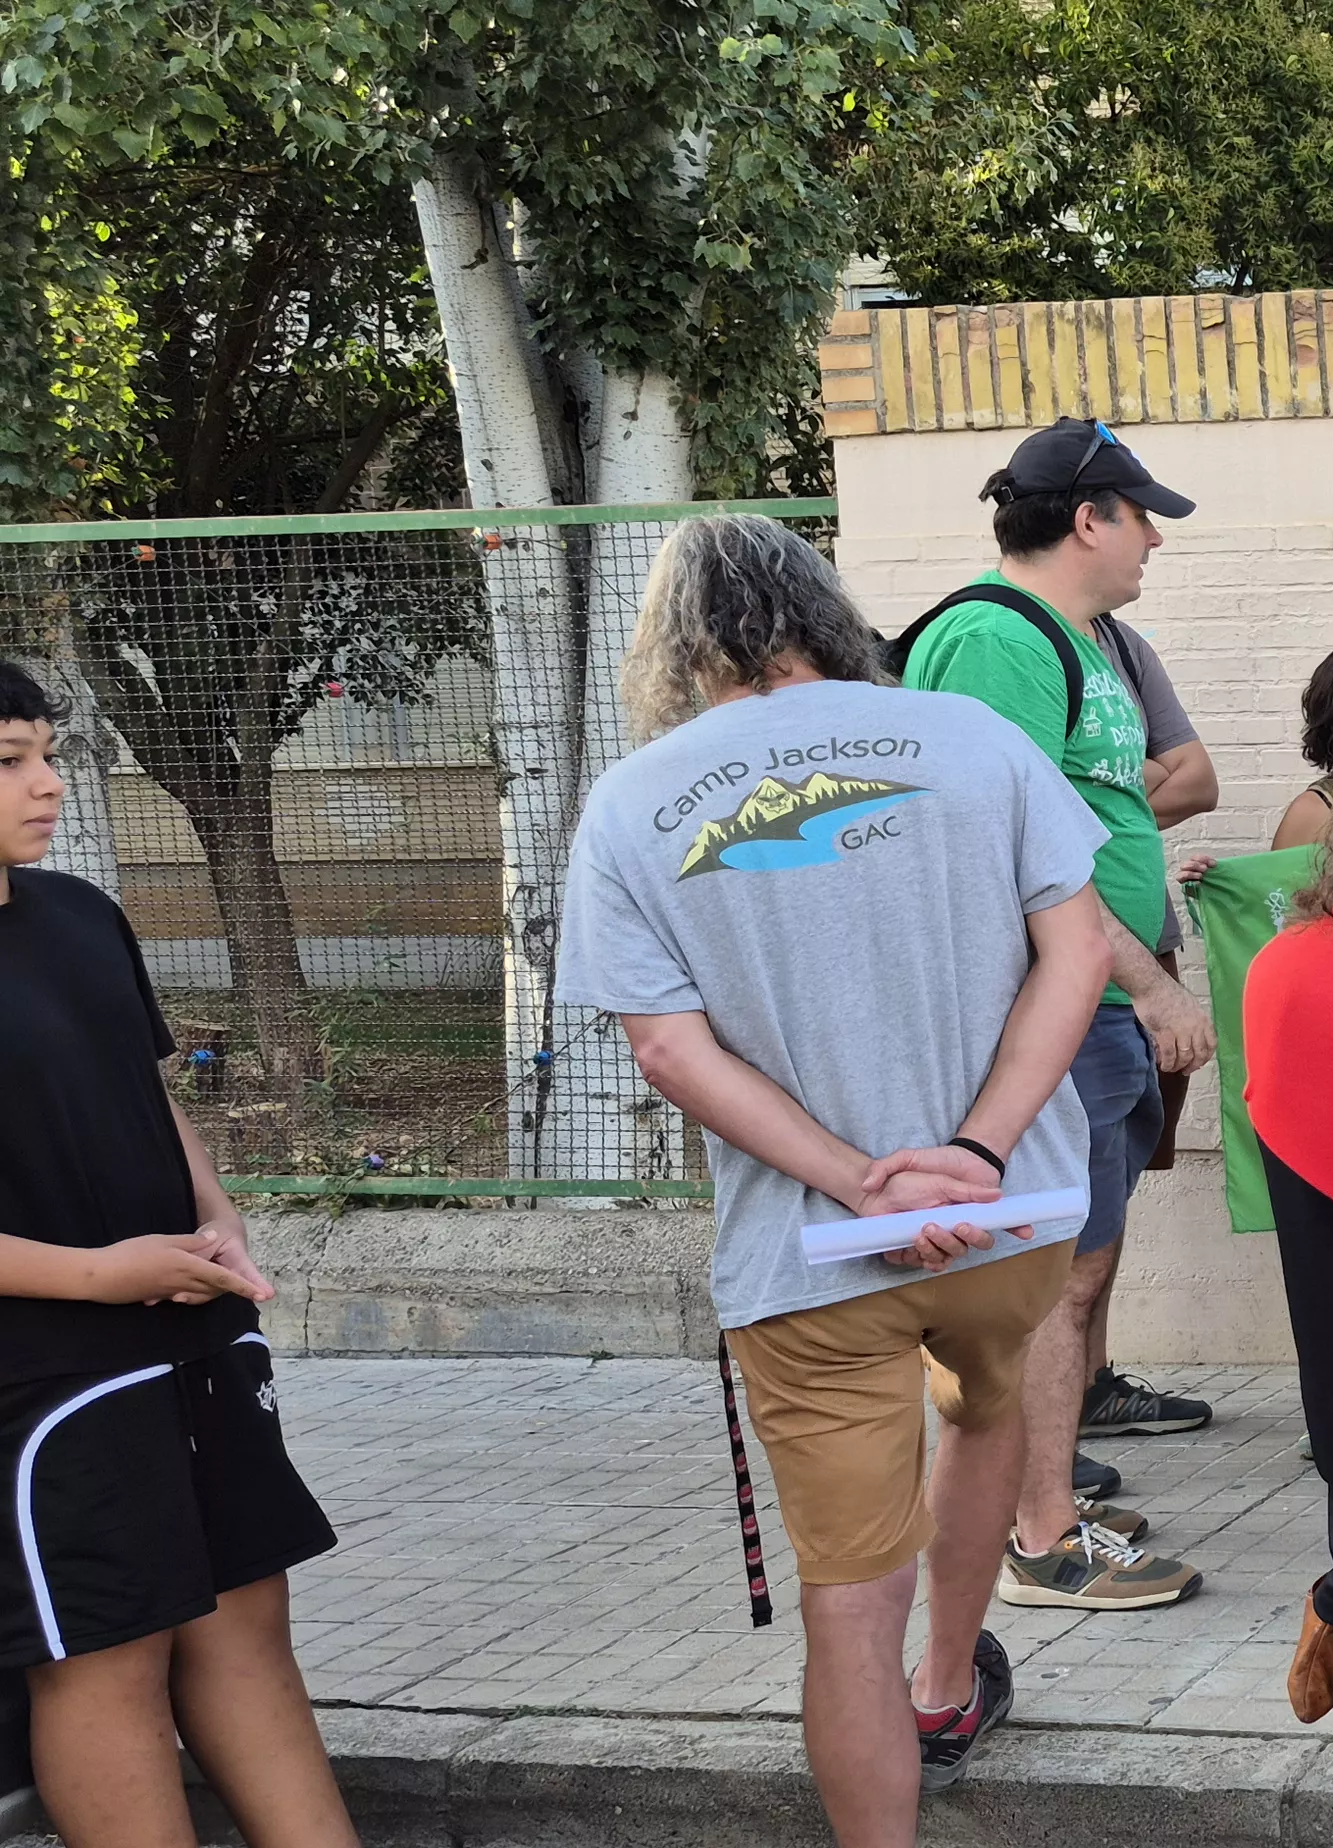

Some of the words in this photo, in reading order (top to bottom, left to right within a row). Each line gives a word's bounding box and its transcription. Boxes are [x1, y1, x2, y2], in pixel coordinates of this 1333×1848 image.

[652, 760, 750, 833] Camp
[765, 736, 922, 771] Jackson
[841, 815, 902, 850] GAC
